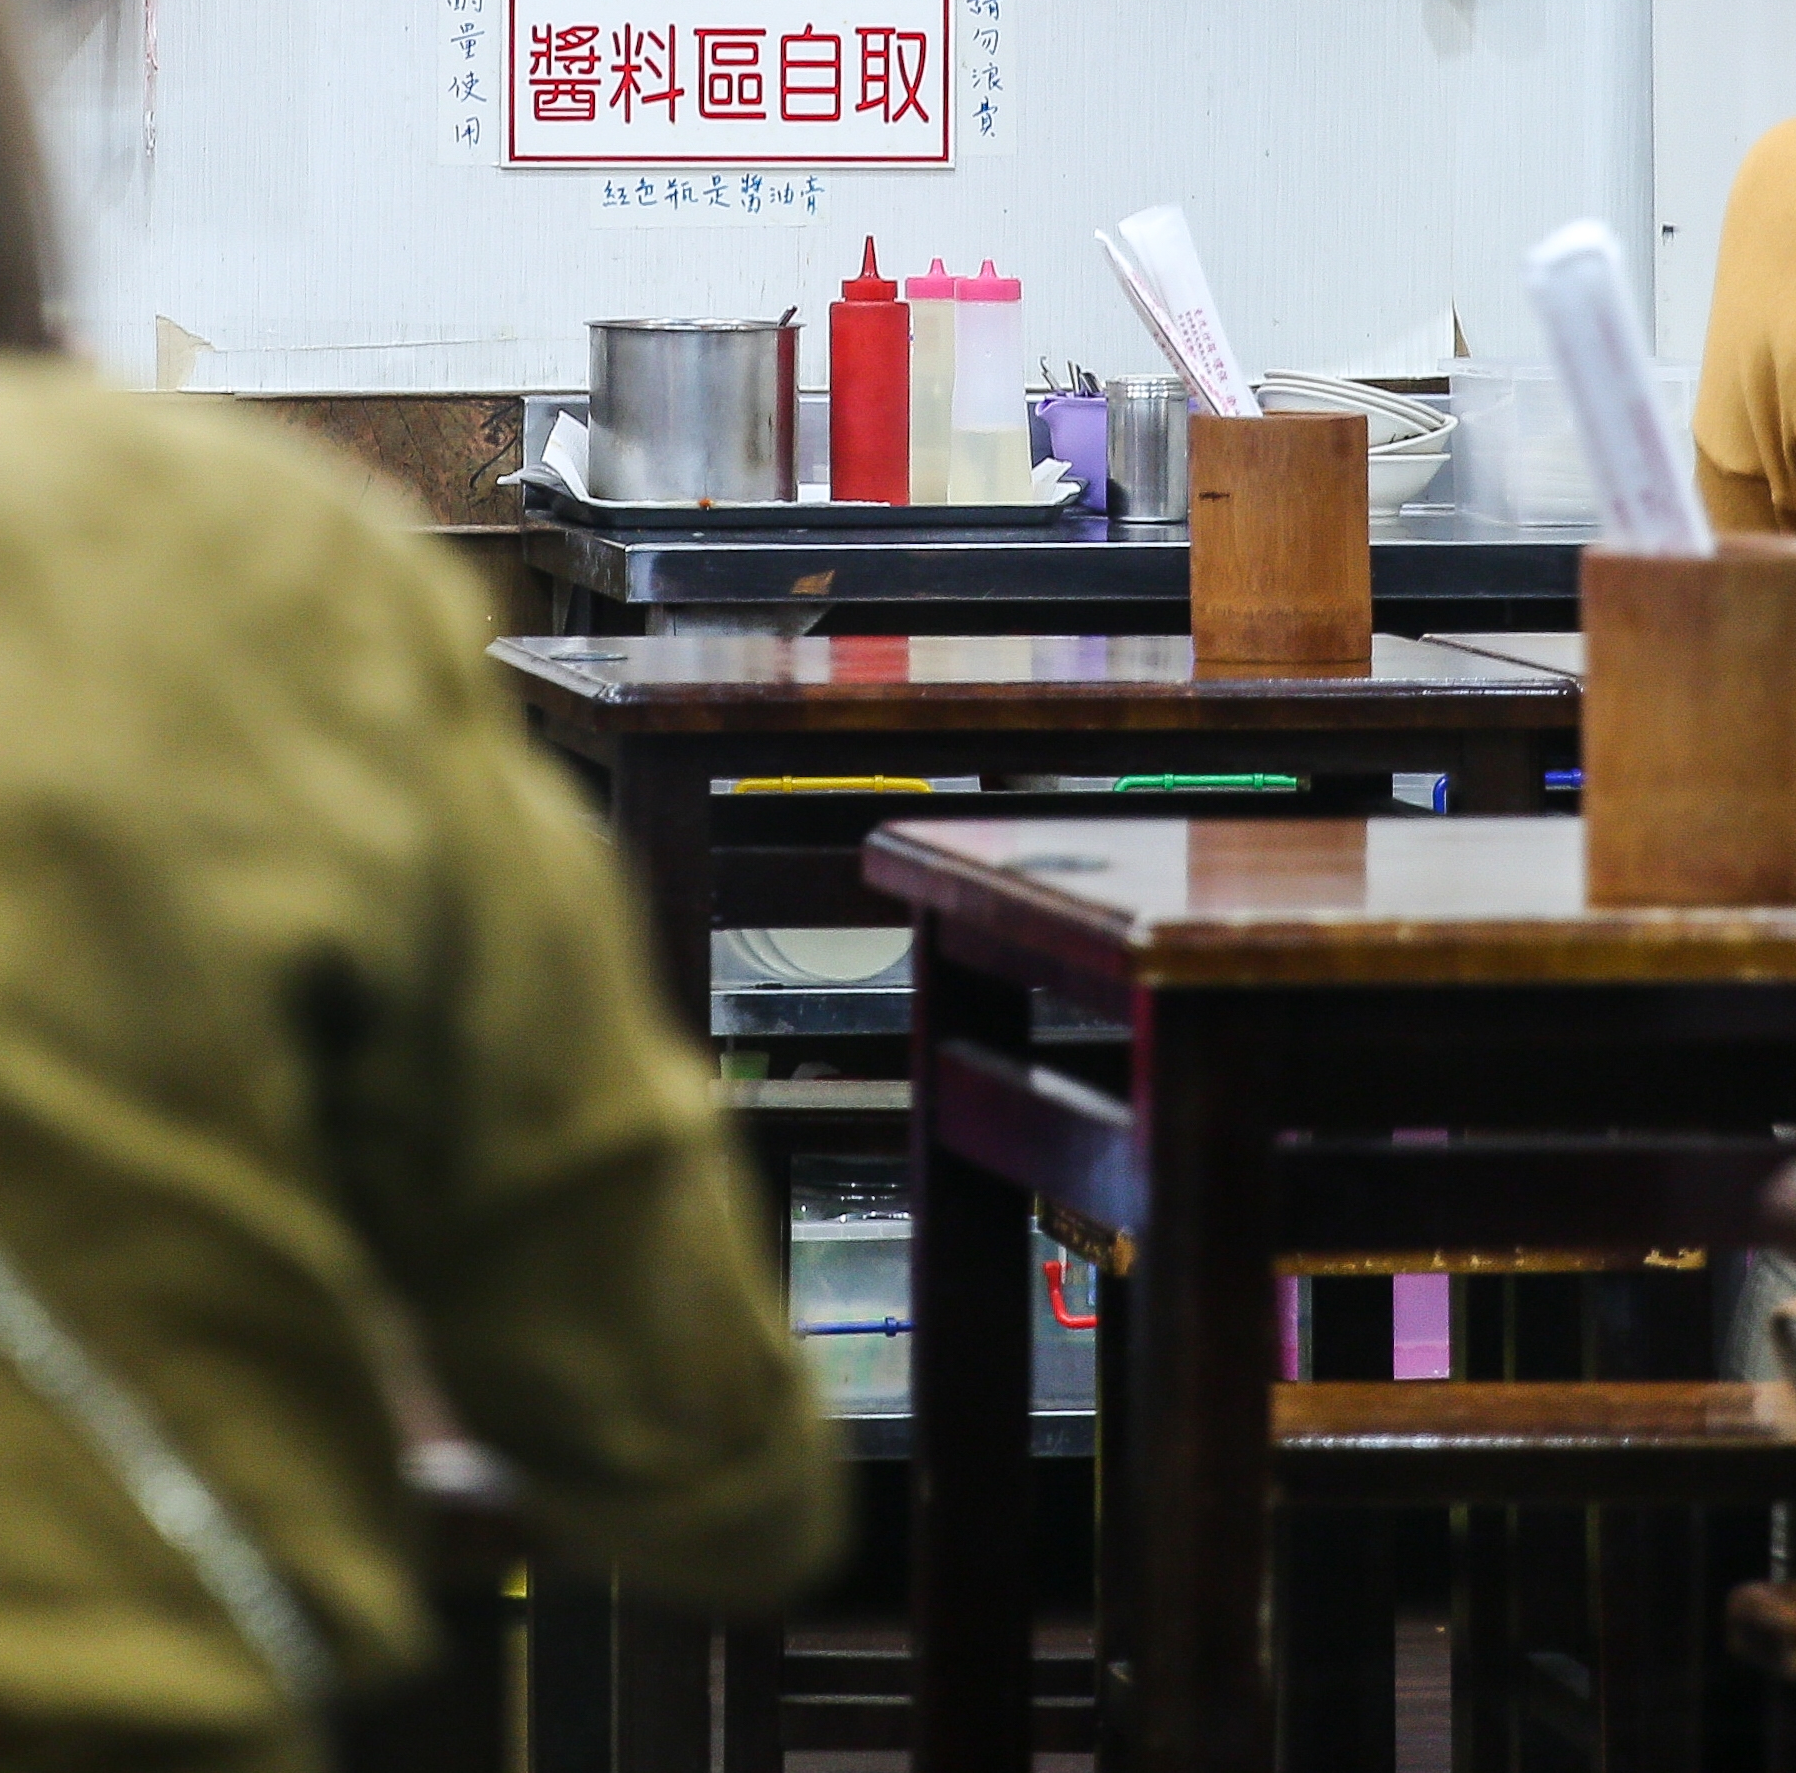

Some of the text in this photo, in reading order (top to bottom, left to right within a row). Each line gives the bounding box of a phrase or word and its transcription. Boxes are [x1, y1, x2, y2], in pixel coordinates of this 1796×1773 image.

[528, 23, 931, 124] 醬料區自取
